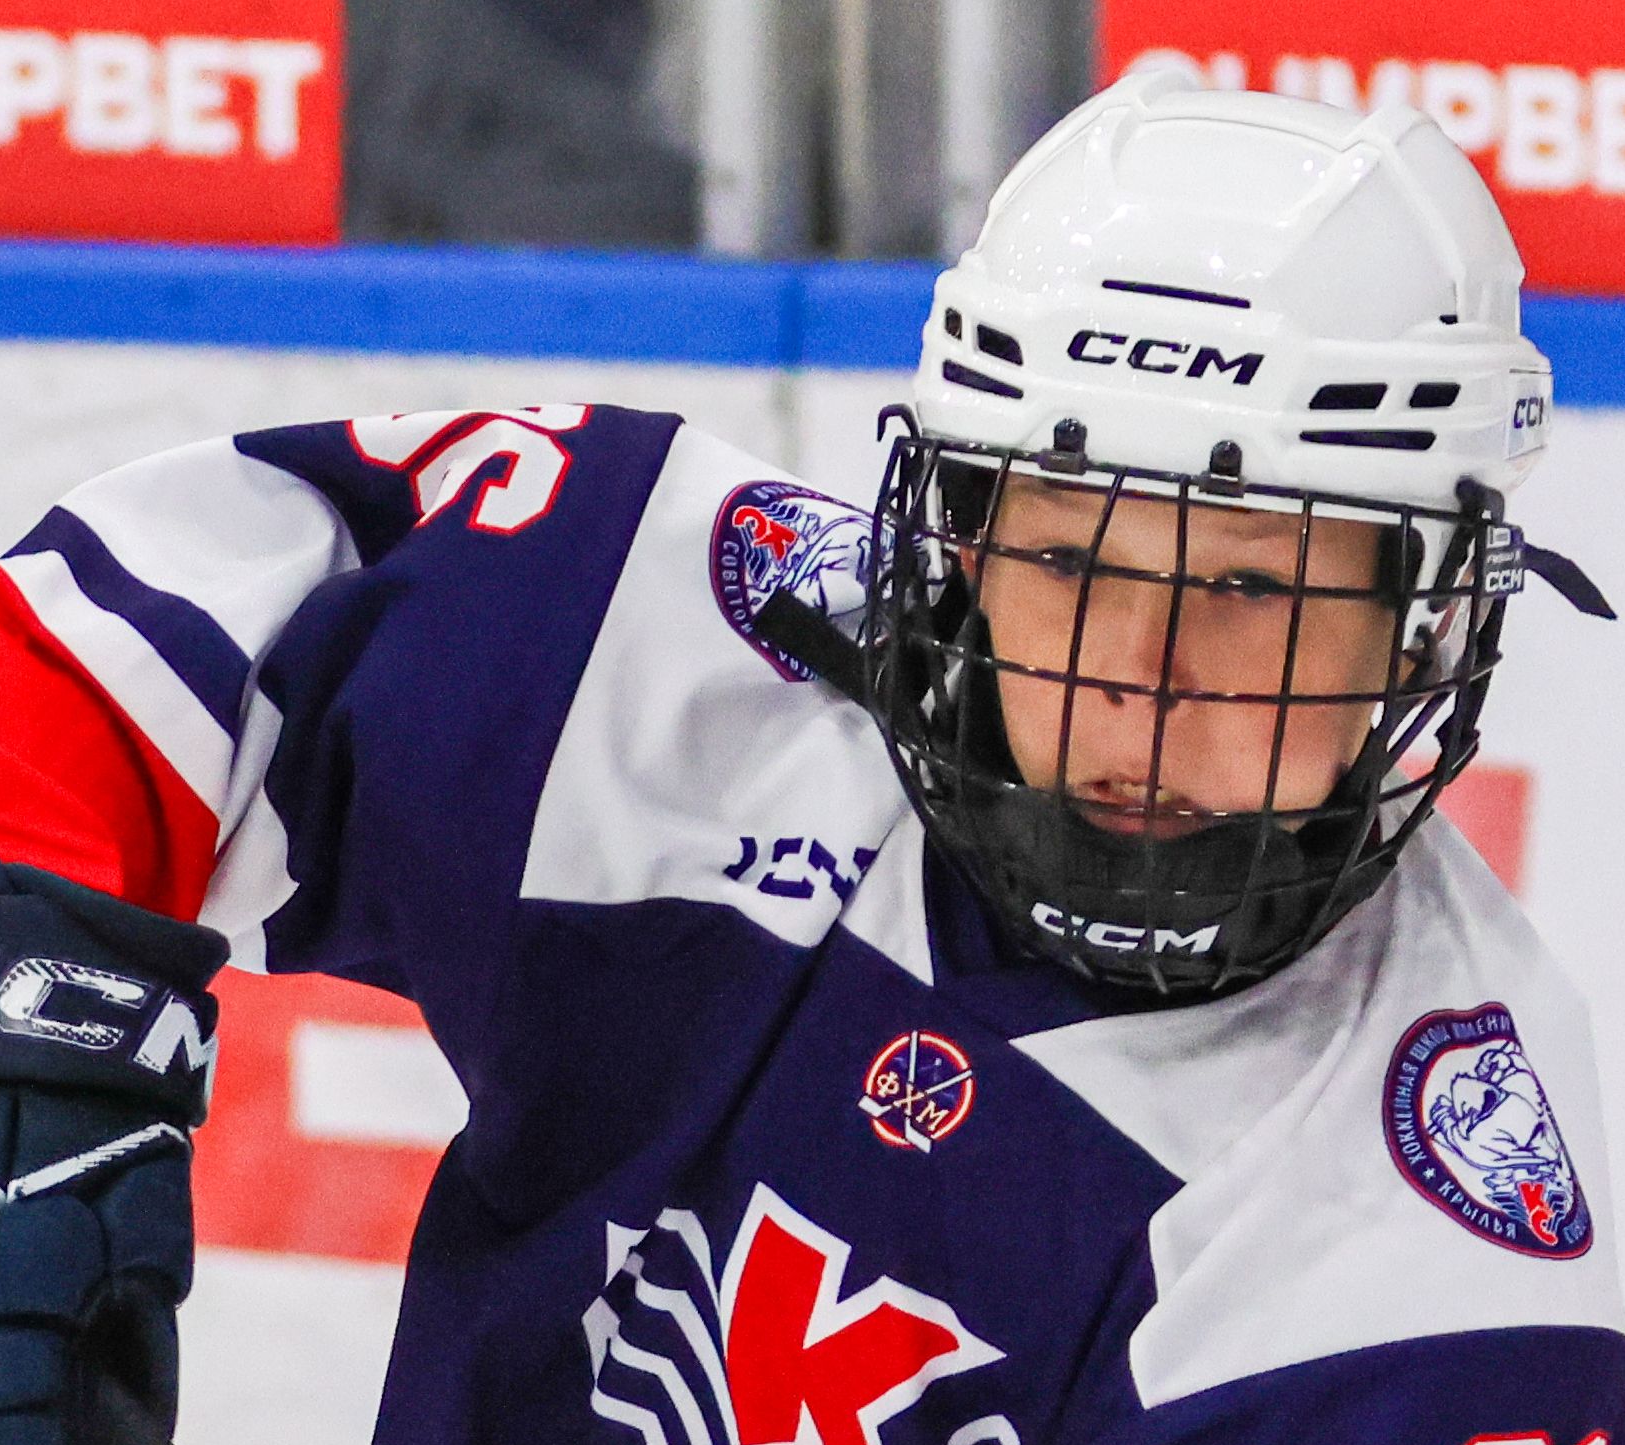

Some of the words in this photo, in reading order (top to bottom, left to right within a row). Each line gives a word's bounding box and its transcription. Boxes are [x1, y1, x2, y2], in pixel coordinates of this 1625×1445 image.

[1066, 329, 1265, 385] CCM
[1028, 901, 1222, 956] CCM
[876, 1071, 950, 1132] ФХМ
[1438, 1180, 1518, 1239] КРЫЛЬЯ
